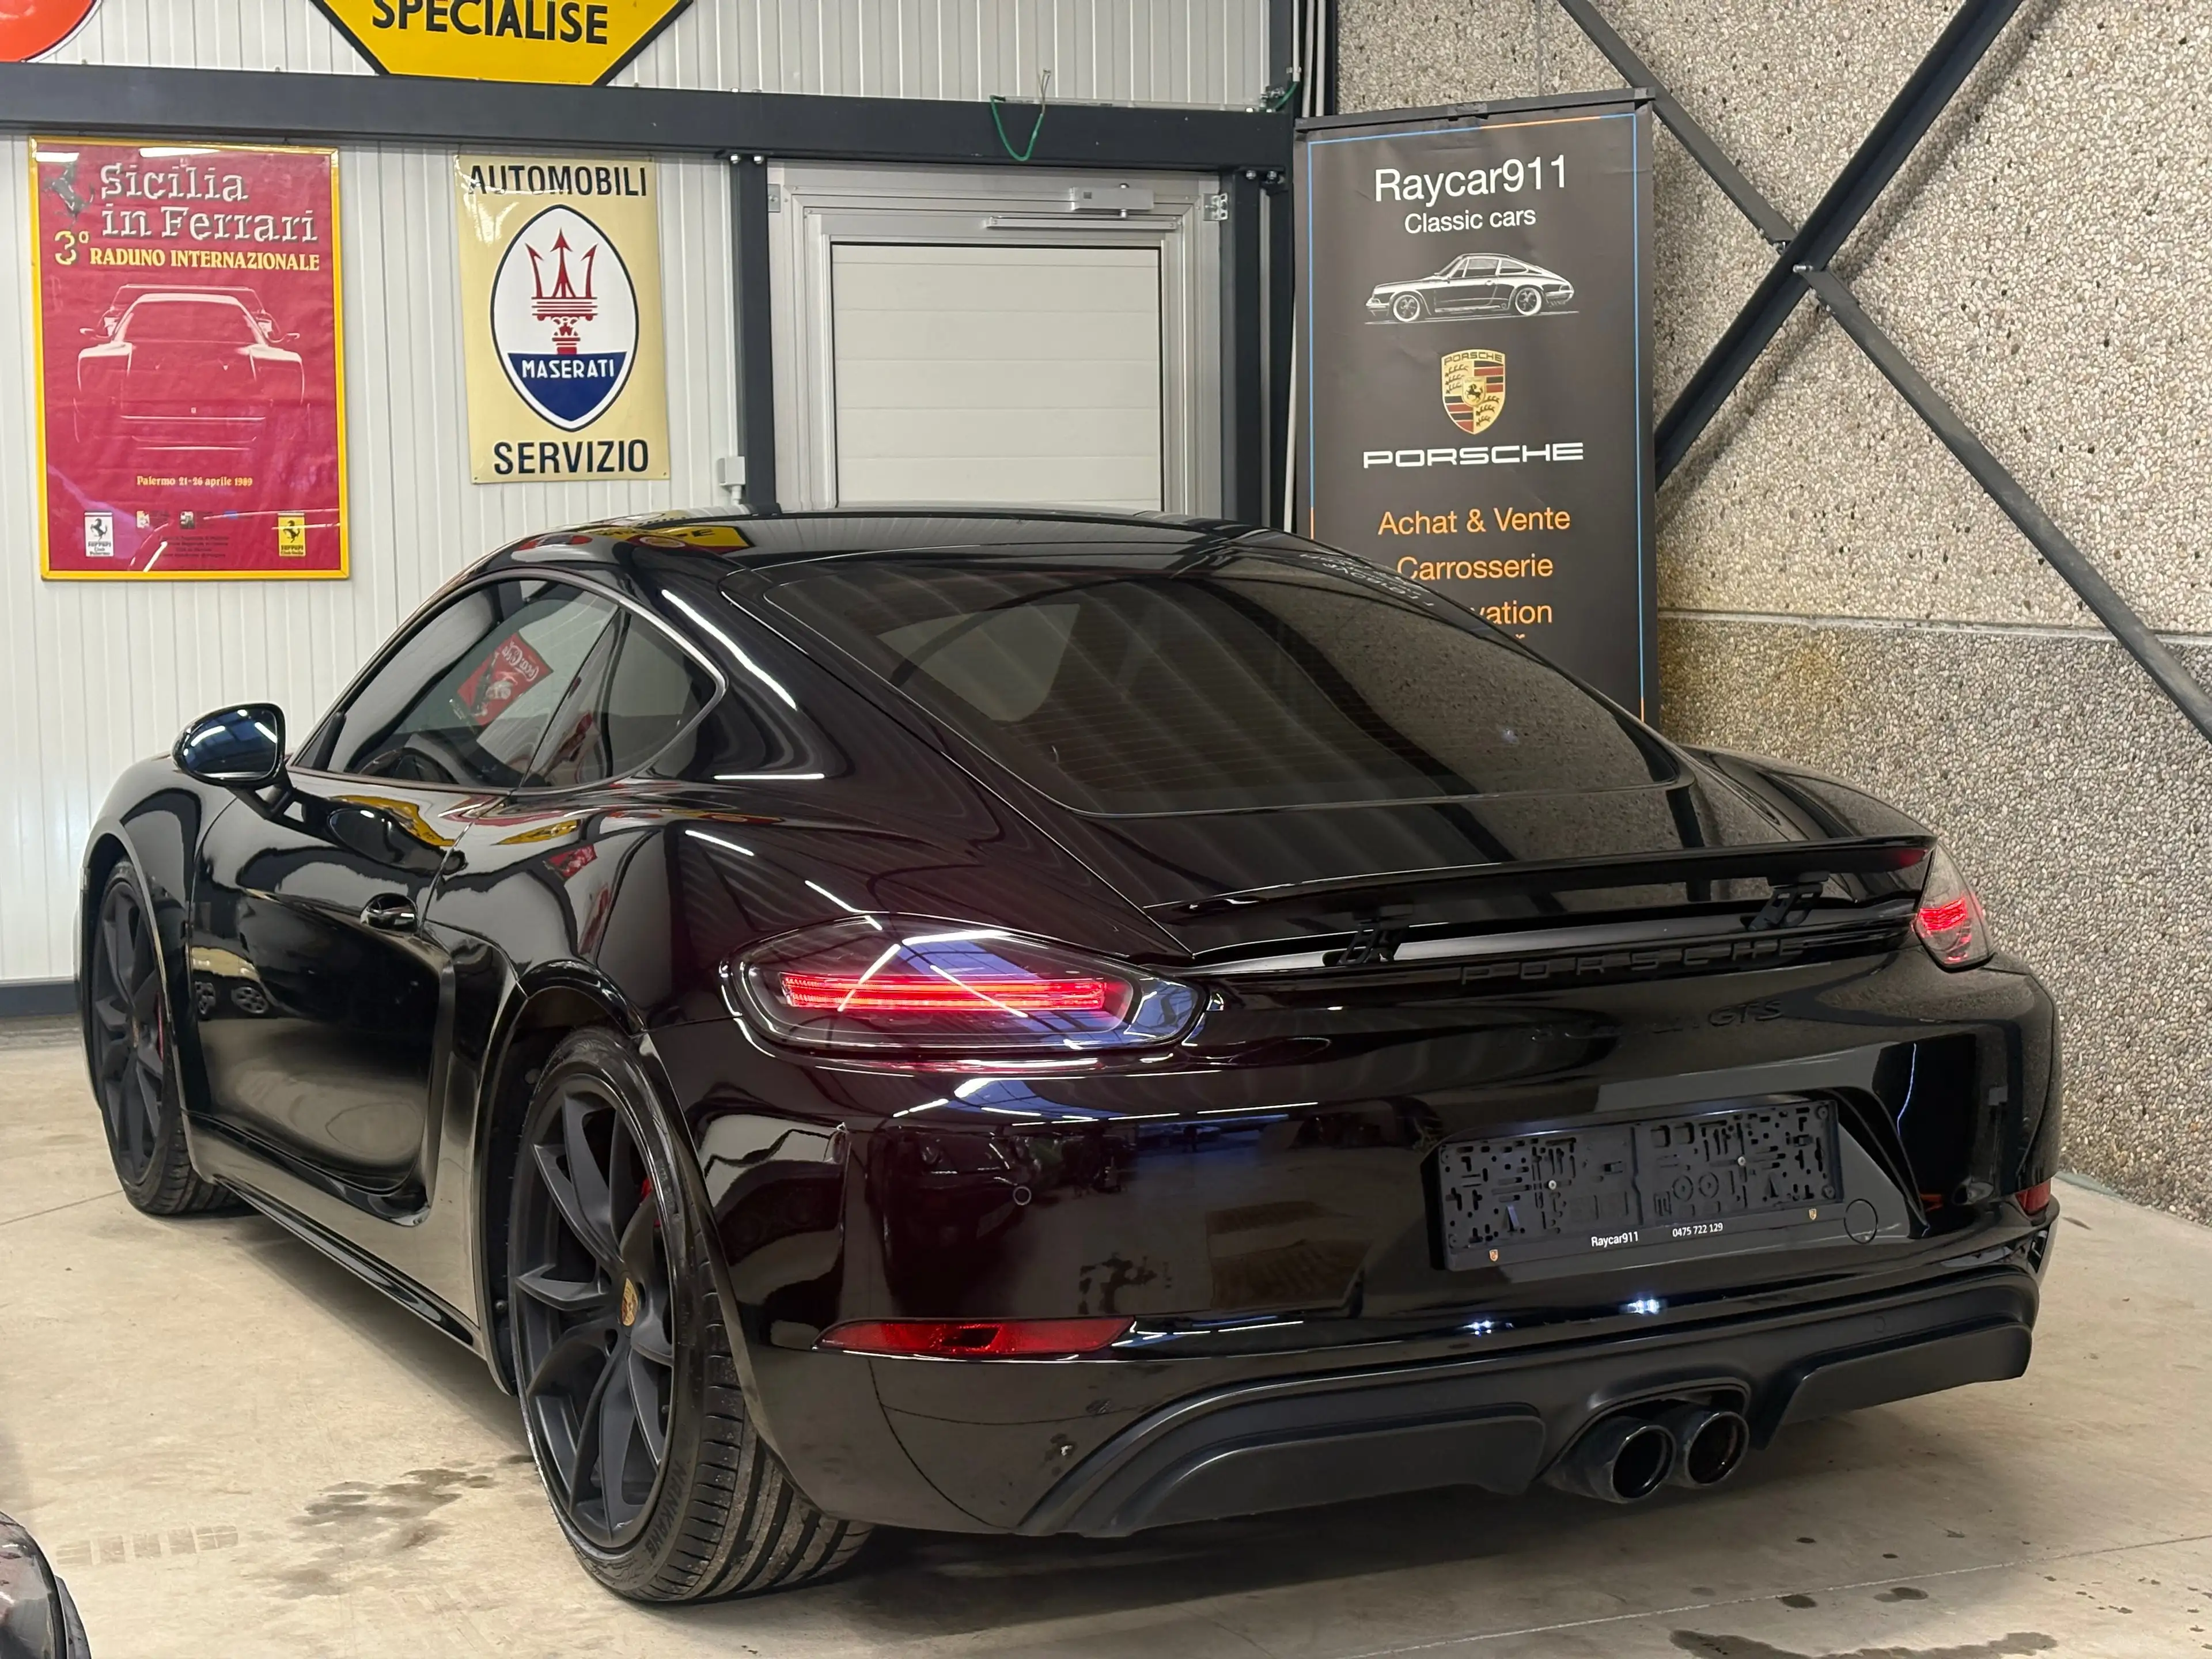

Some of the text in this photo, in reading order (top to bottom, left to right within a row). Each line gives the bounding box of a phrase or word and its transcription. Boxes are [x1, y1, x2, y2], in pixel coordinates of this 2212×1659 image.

[372, 0, 608, 44] SPECIALISE
[100, 162, 248, 202] Sicilia
[468, 165, 647, 197] AUTOMOBILI
[1374, 154, 1566, 207] Raycar911
[101, 202, 318, 242] in Ferrari
[1404, 208, 1536, 234] Classic cars
[90, 247, 165, 267] RADUNO
[170, 249, 320, 271] INTERNAZIONALE
[522, 359, 616, 380] MASERATI
[1444, 351, 1503, 366] PORSCHE
[493, 438, 649, 475] SERVIZIO
[1363, 442, 1584, 469] PORSCHE
[137, 475, 176, 486] Palermo
[179, 476, 203, 486] 21-26
[204, 476, 232, 488] aprile
[1377, 507, 1571, 535] Achat & Vente
[1396, 553, 1554, 581] Carrosserie
[1461, 939, 1805, 985] PORSCHE
[1707, 999, 1784, 1027] GTS
[1590, 1230, 1639, 1248] Raycar911
[1672, 1222, 1724, 1238] 0475 722 129
